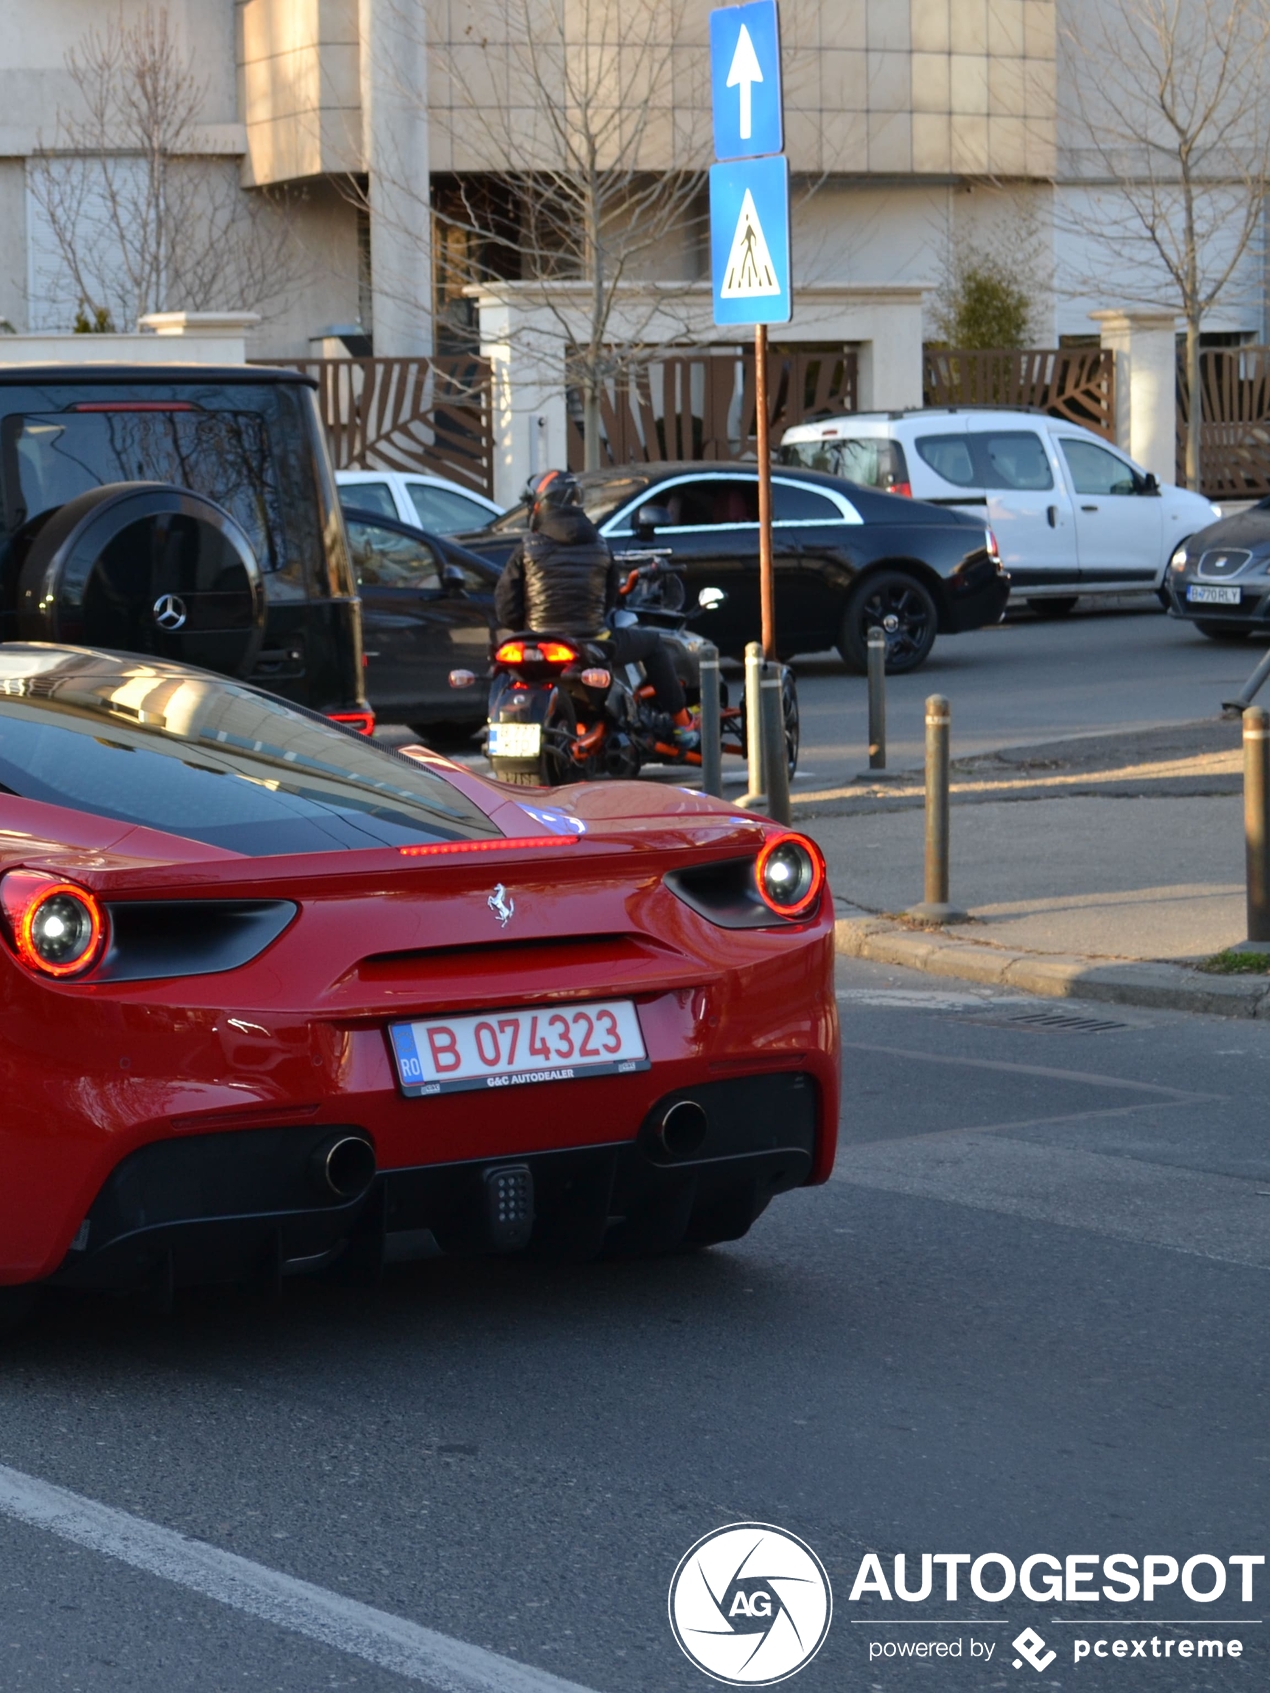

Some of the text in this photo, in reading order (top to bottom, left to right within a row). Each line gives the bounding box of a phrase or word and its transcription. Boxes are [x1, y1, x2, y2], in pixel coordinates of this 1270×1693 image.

[400, 1009, 622, 1077] RO B 074323
[487, 1069, 574, 1087] G&C AUTODEALER
